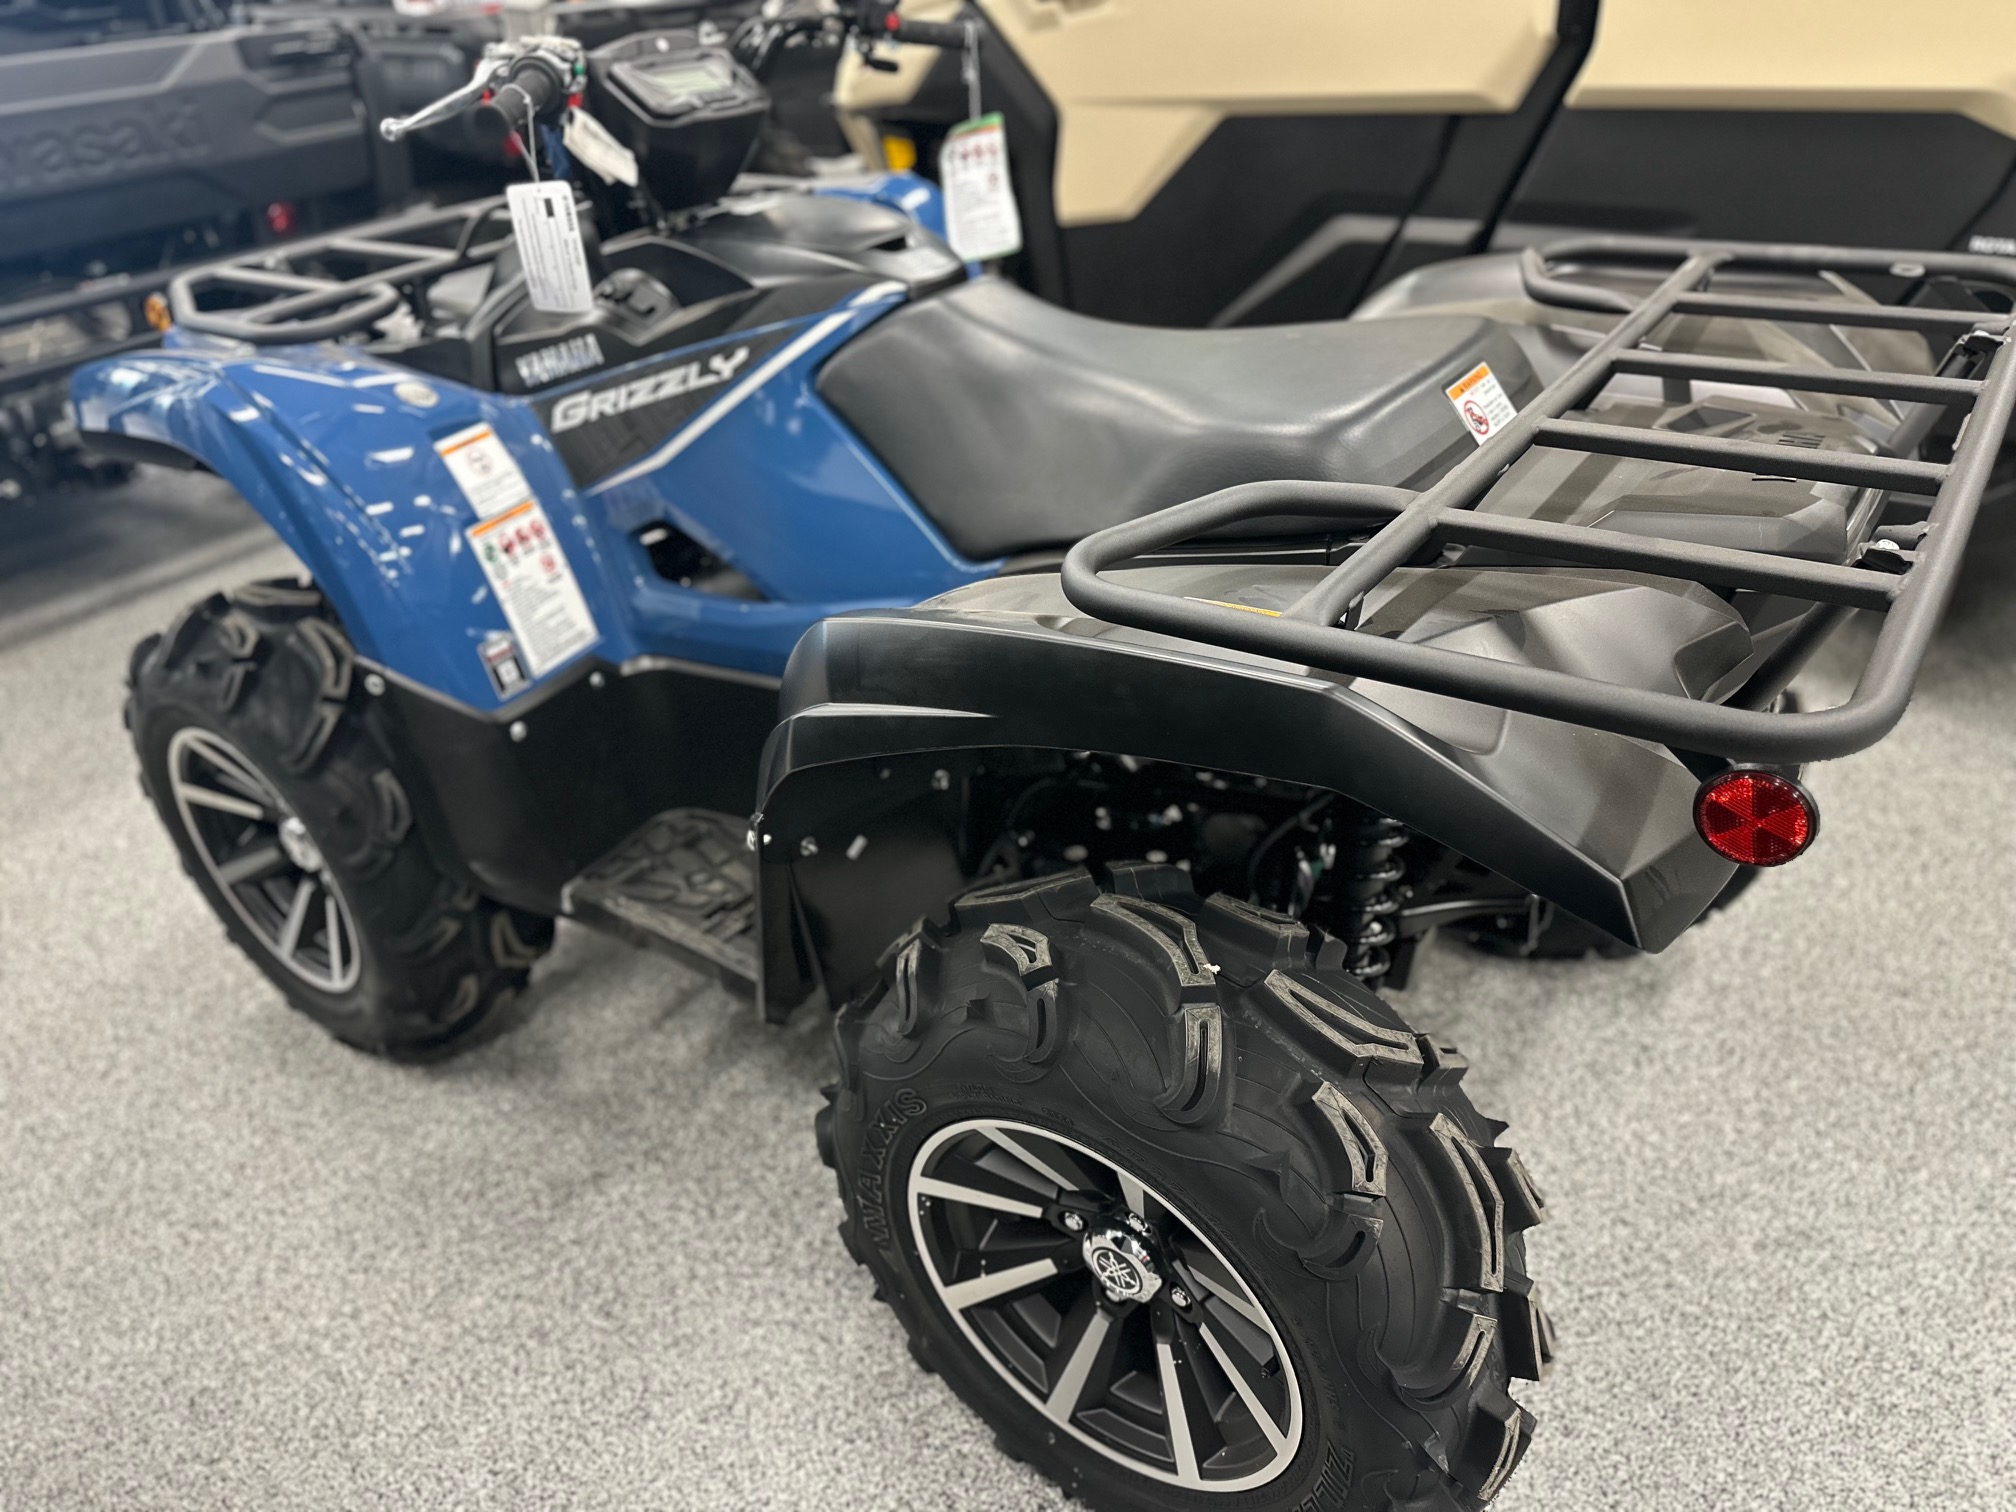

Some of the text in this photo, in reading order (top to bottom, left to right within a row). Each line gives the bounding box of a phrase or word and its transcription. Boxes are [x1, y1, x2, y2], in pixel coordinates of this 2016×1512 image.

[516, 333, 605, 387] YAMAHA
[551, 346, 749, 433] GRIZZLY
[857, 1087, 926, 1246] MAXXIS
